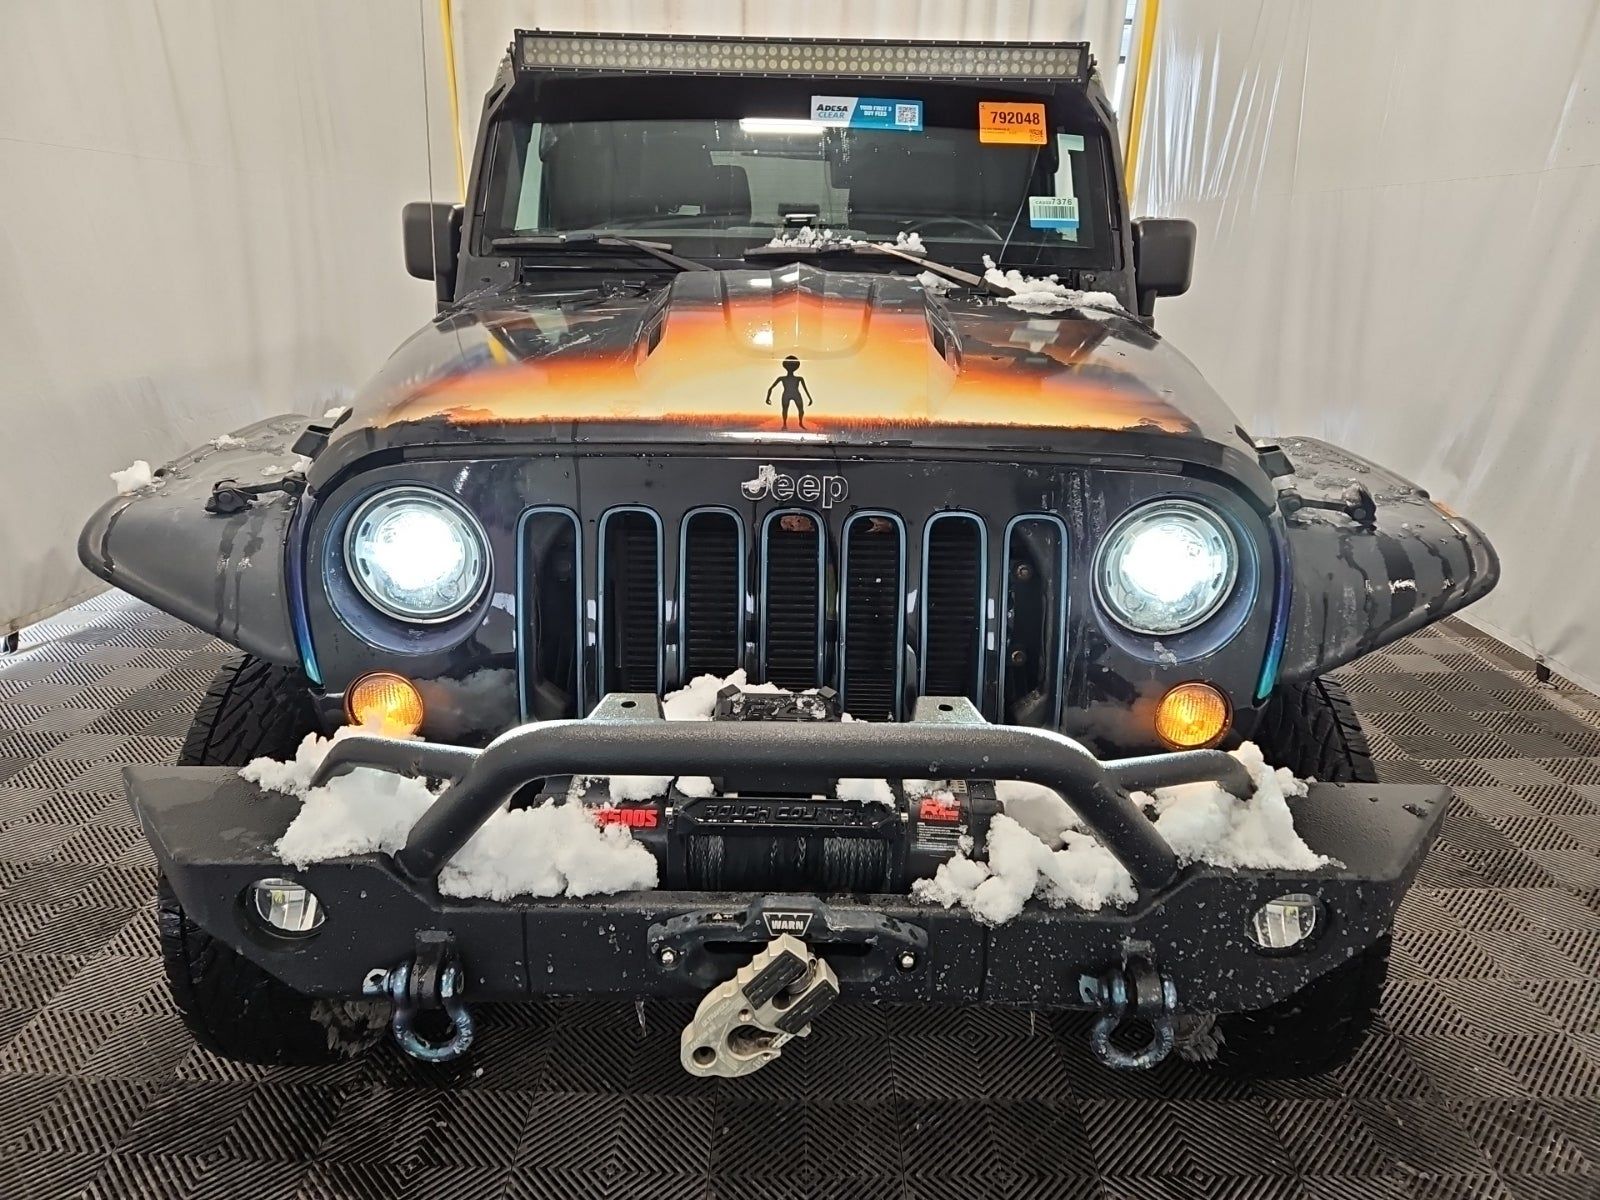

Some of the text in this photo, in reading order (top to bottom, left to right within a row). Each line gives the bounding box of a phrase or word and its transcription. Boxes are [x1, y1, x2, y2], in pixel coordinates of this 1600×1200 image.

[816, 103, 848, 112] ADESA
[990, 111, 1040, 125] 792048
[741, 464, 849, 508] Jeep
[705, 804, 771, 819] ROUGH
[771, 920, 804, 930] WARN
